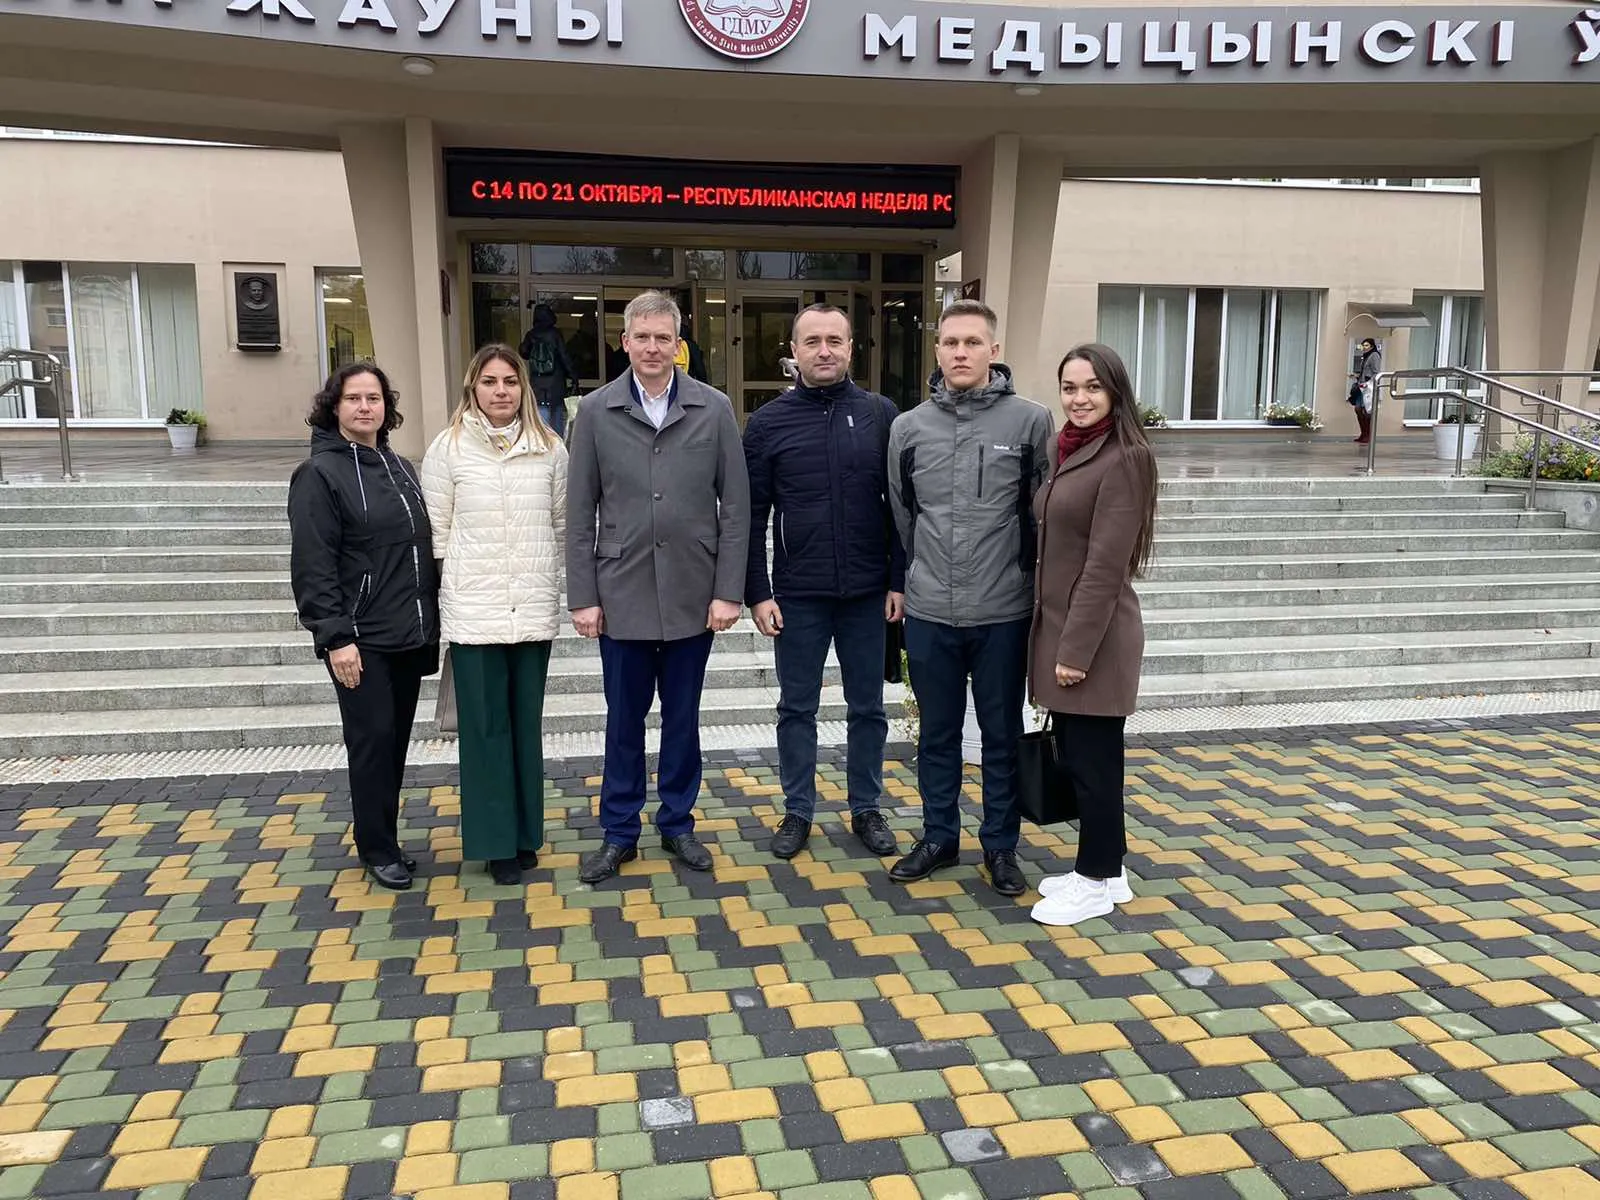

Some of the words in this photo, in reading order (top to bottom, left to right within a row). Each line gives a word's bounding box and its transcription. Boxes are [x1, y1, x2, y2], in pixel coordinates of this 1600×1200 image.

[720, 16, 771, 37] ГДМУ
[864, 13, 1515, 71] МЕДЫЦЫНСКІ
[471, 181, 486, 199] С
[490, 181, 514, 200] 14
[518, 182, 548, 201] ПО
[552, 183, 575, 202] 21
[579, 183, 663, 204] ОКТЯБРЯ
[684, 187, 857, 209] РЕСПУБЛИКАНСКАЯ
[861, 192, 928, 214] НЕДЕЛЯ
